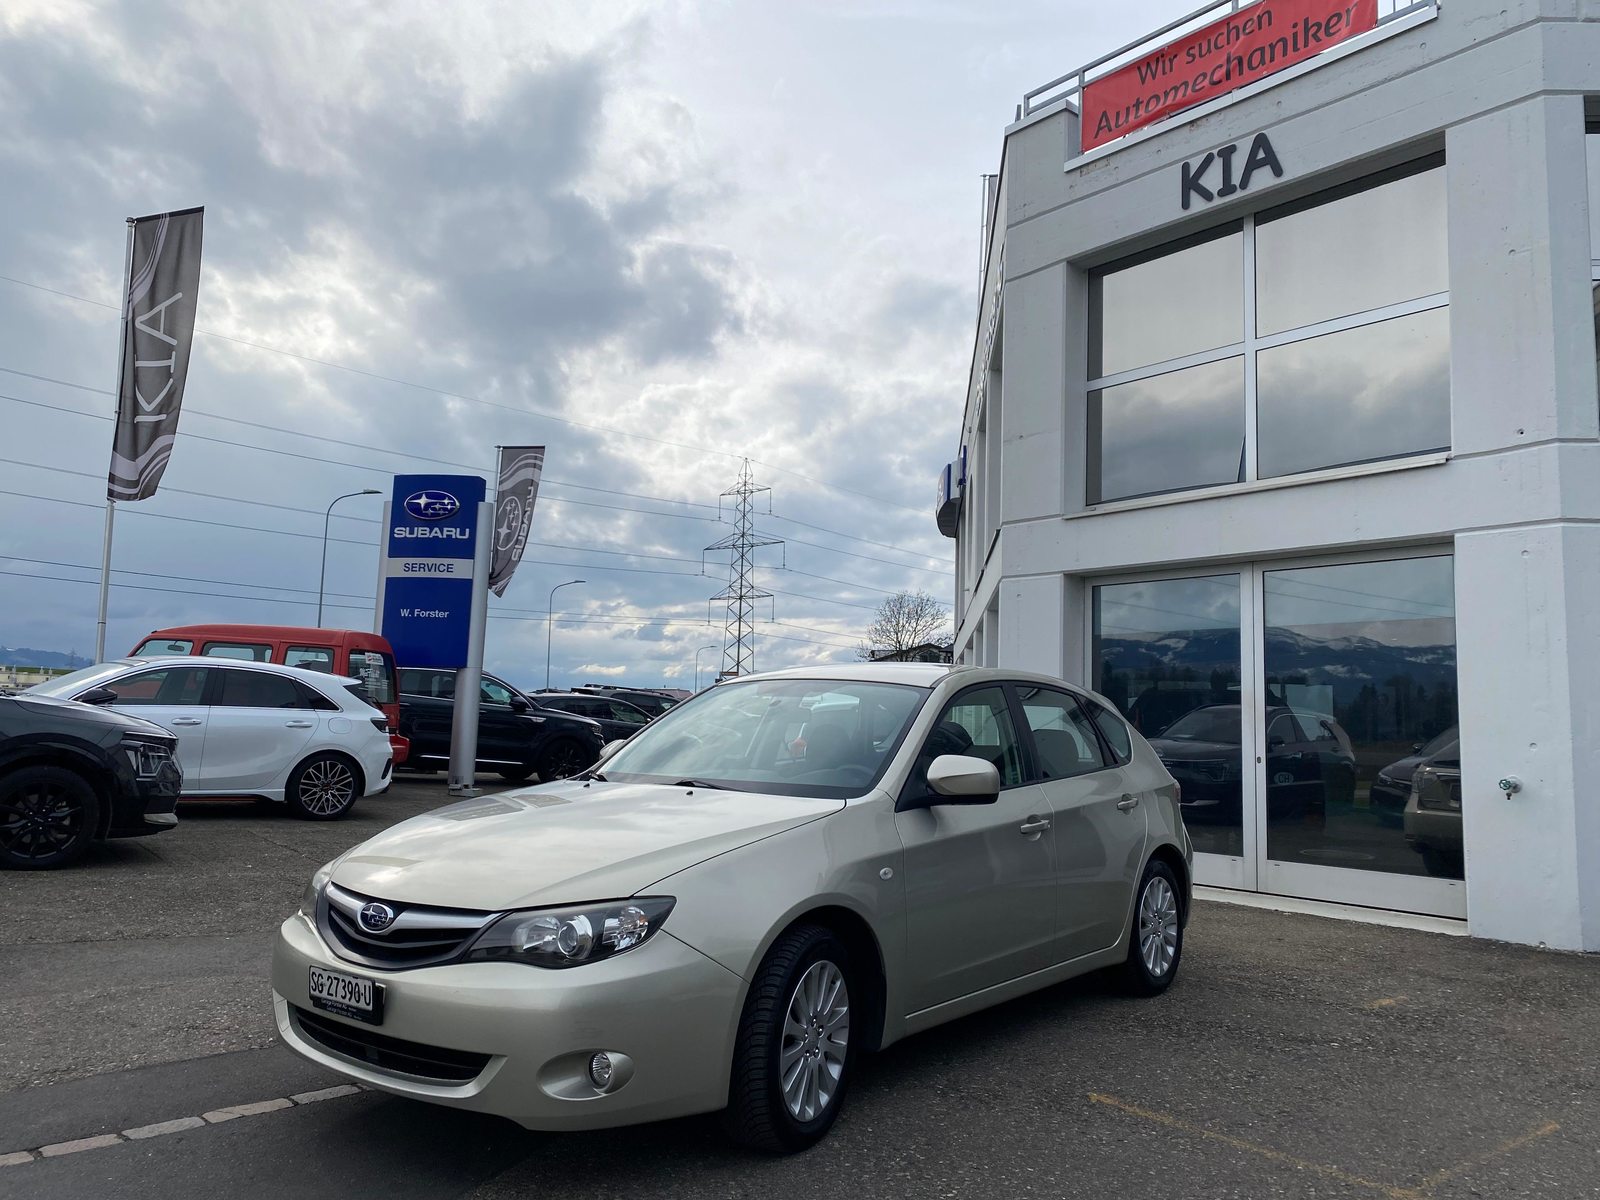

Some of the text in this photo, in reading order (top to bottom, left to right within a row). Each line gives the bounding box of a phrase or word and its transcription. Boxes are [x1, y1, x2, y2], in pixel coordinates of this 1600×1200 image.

[1093, 2, 1358, 140] Automechaniker
[1137, 9, 1273, 86] Wir suchen
[1181, 132, 1284, 210] KIA
[134, 292, 183, 424] KIA
[393, 526, 470, 540] SUBARU
[403, 562, 454, 573] SERVICE
[400, 608, 449, 618] W. Forster
[311, 971, 324, 994] SG
